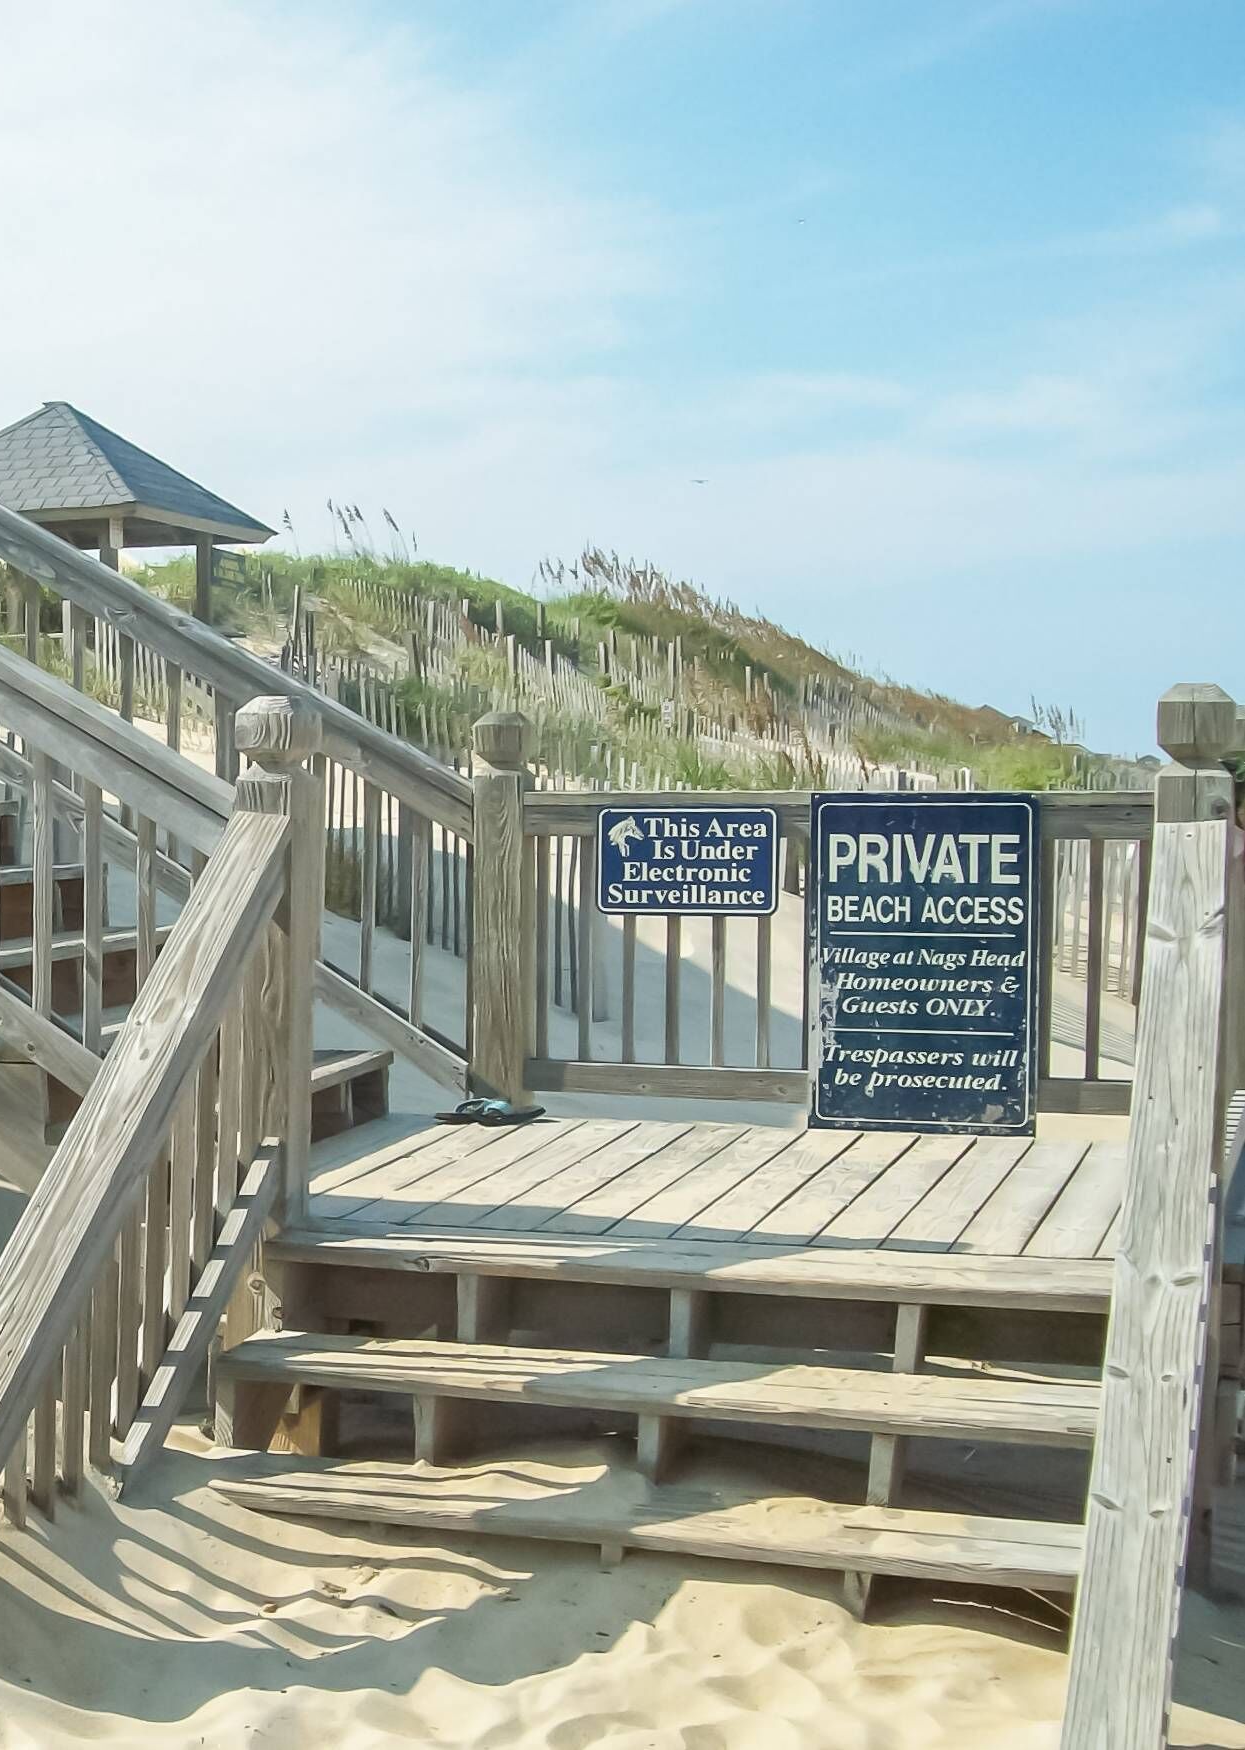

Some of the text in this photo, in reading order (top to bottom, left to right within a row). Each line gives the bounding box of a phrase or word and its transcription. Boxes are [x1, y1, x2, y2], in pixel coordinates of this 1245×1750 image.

[644, 818, 767, 837] This Area
[652, 840, 759, 860] Is Under
[829, 834, 1021, 884] PRIVATE
[622, 862, 751, 882] Electronic
[608, 883, 765, 904] Surveillance
[827, 895, 1024, 925] BEACH ACCESS
[823, 947, 1025, 970] Village at Nags Head
[837, 973, 1020, 993] Homeowners &
[842, 997, 996, 1017] Guests ONLY.
[822, 1045, 1018, 1067] Trespassers will
[834, 1069, 1007, 1092] be prosecuted.
